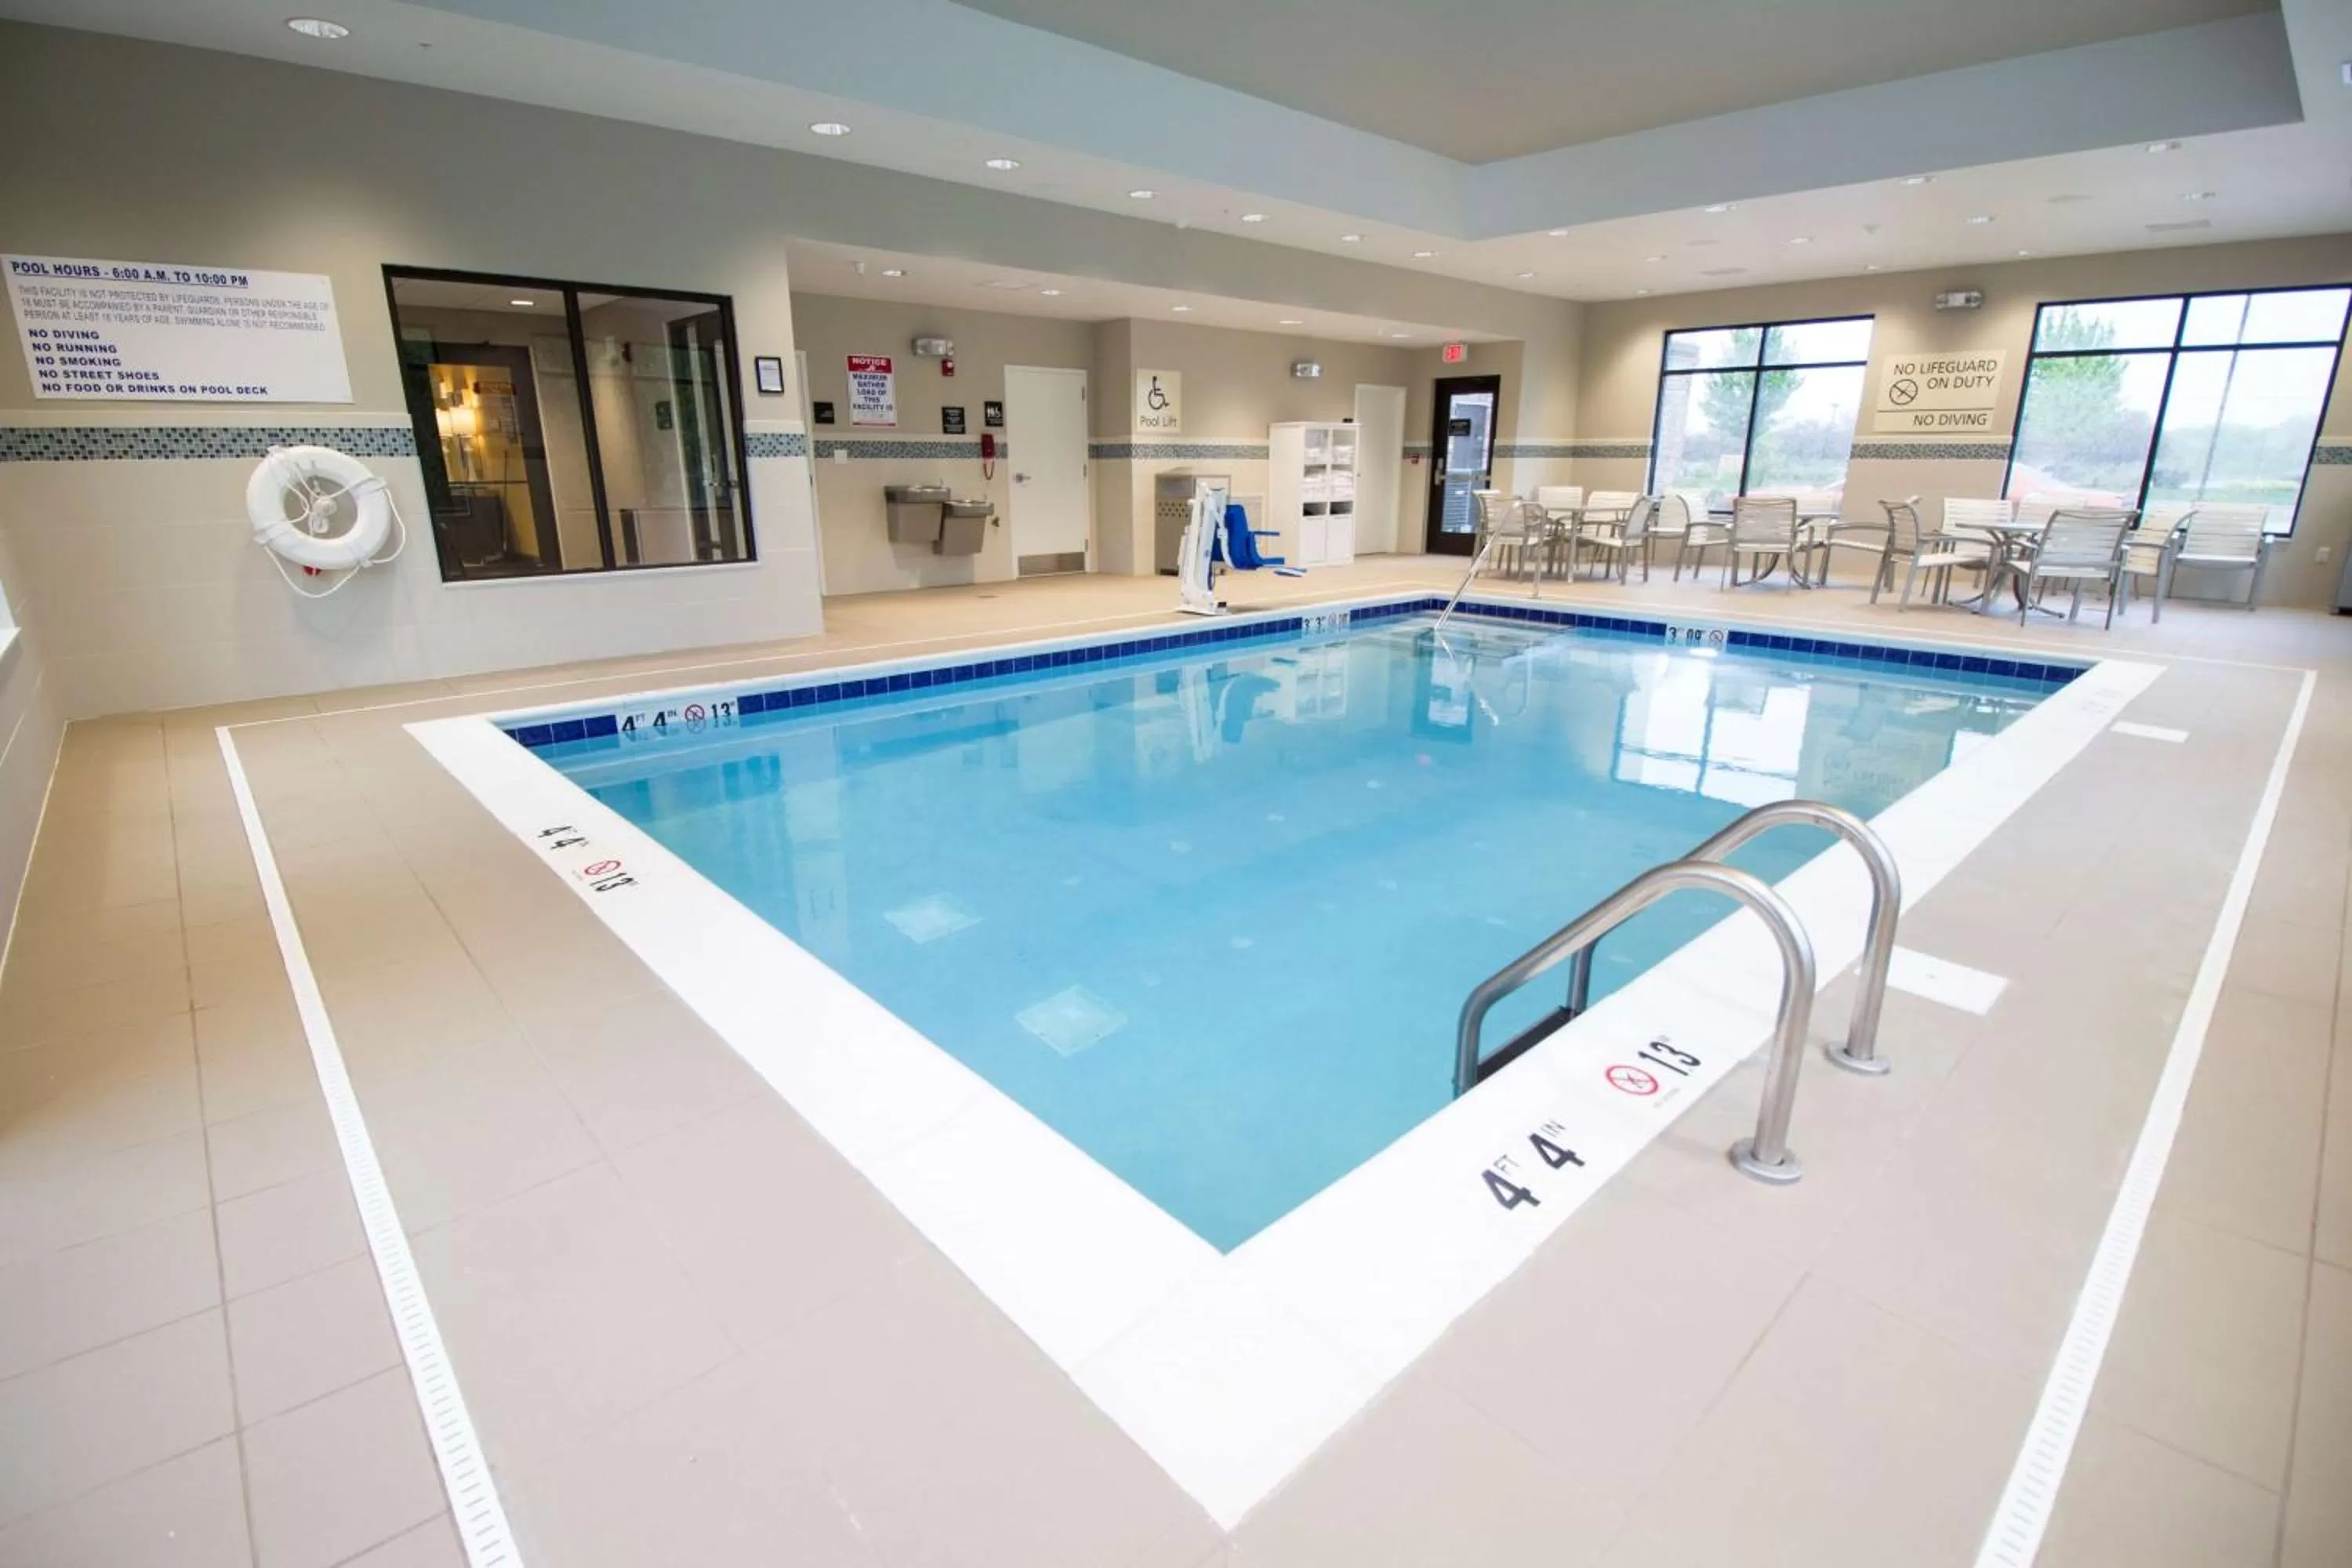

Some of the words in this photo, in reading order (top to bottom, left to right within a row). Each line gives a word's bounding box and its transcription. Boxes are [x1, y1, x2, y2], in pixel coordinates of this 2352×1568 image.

[10, 261, 49, 274] POOL
[53, 264, 100, 276] HOURS
[113, 268, 139, 279] 6:00
[144, 270, 170, 281] A.M.
[173, 271, 191, 282] TO
[196, 274, 227, 285] 10:00
[230, 275, 249, 285] PM
[28, 329, 48, 338] NO
[53, 330, 100, 339] DIVING
[32, 343, 51, 352] NO
[56, 343, 118, 354] RUNNING
[36, 356, 54, 365] NO
[60, 357, 122, 366] SMOKING
[852, 357, 887, 365] NOTICE
[1893, 363, 1915, 376] NO
[1919, 360, 1998, 375] LIFEGUARD
[38, 369, 58, 378] NO
[63, 370, 112, 379] STREET
[118, 372, 159, 380] SHOES
[42, 383, 61, 392] NO
[66, 383, 101, 393] FOOD
[106, 383, 124, 393] OR
[128, 384, 176, 394] DRINKS
[180, 385, 197, 394] ON
[200, 385, 233, 394] POOL
[236, 386, 268, 395] DECK
[1927, 377, 1949, 390] ON
[1953, 376, 1995, 390] DUTY
[1140, 415, 1160, 427] Pool
[1163, 416, 1177, 427] Lift
[1913, 414, 1935, 426] NO
[1938, 413, 1987, 426] DIVING
[1481, 1169, 1541, 1210] 4
[1528, 1133, 1585, 1170] 4
